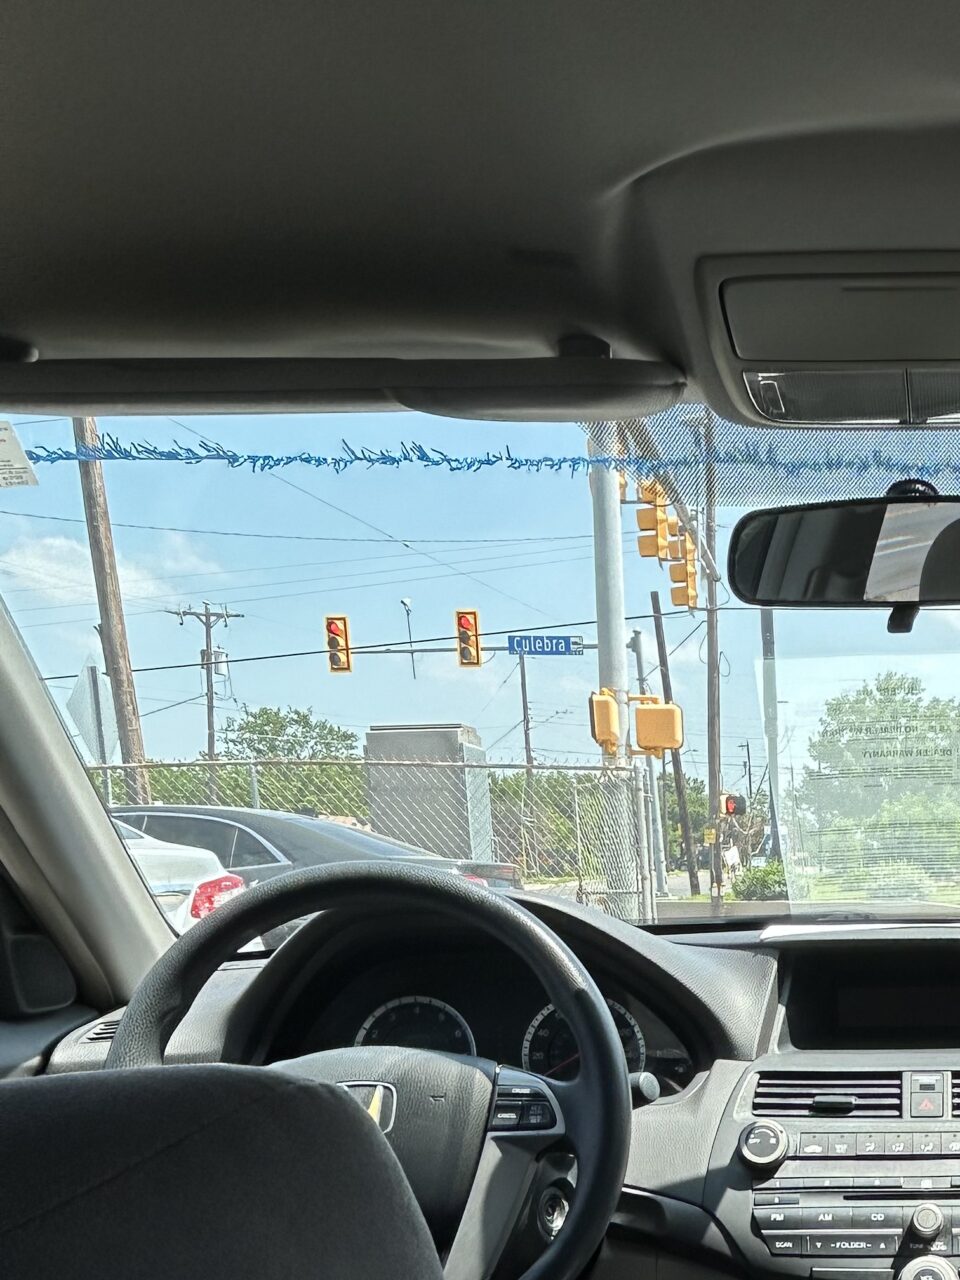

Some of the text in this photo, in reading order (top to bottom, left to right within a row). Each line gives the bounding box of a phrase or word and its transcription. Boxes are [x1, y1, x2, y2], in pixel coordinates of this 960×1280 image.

[513, 635, 566, 652] Culebra
[818, 1213, 833, 1221] AM
[870, 1213, 885, 1221] CD
